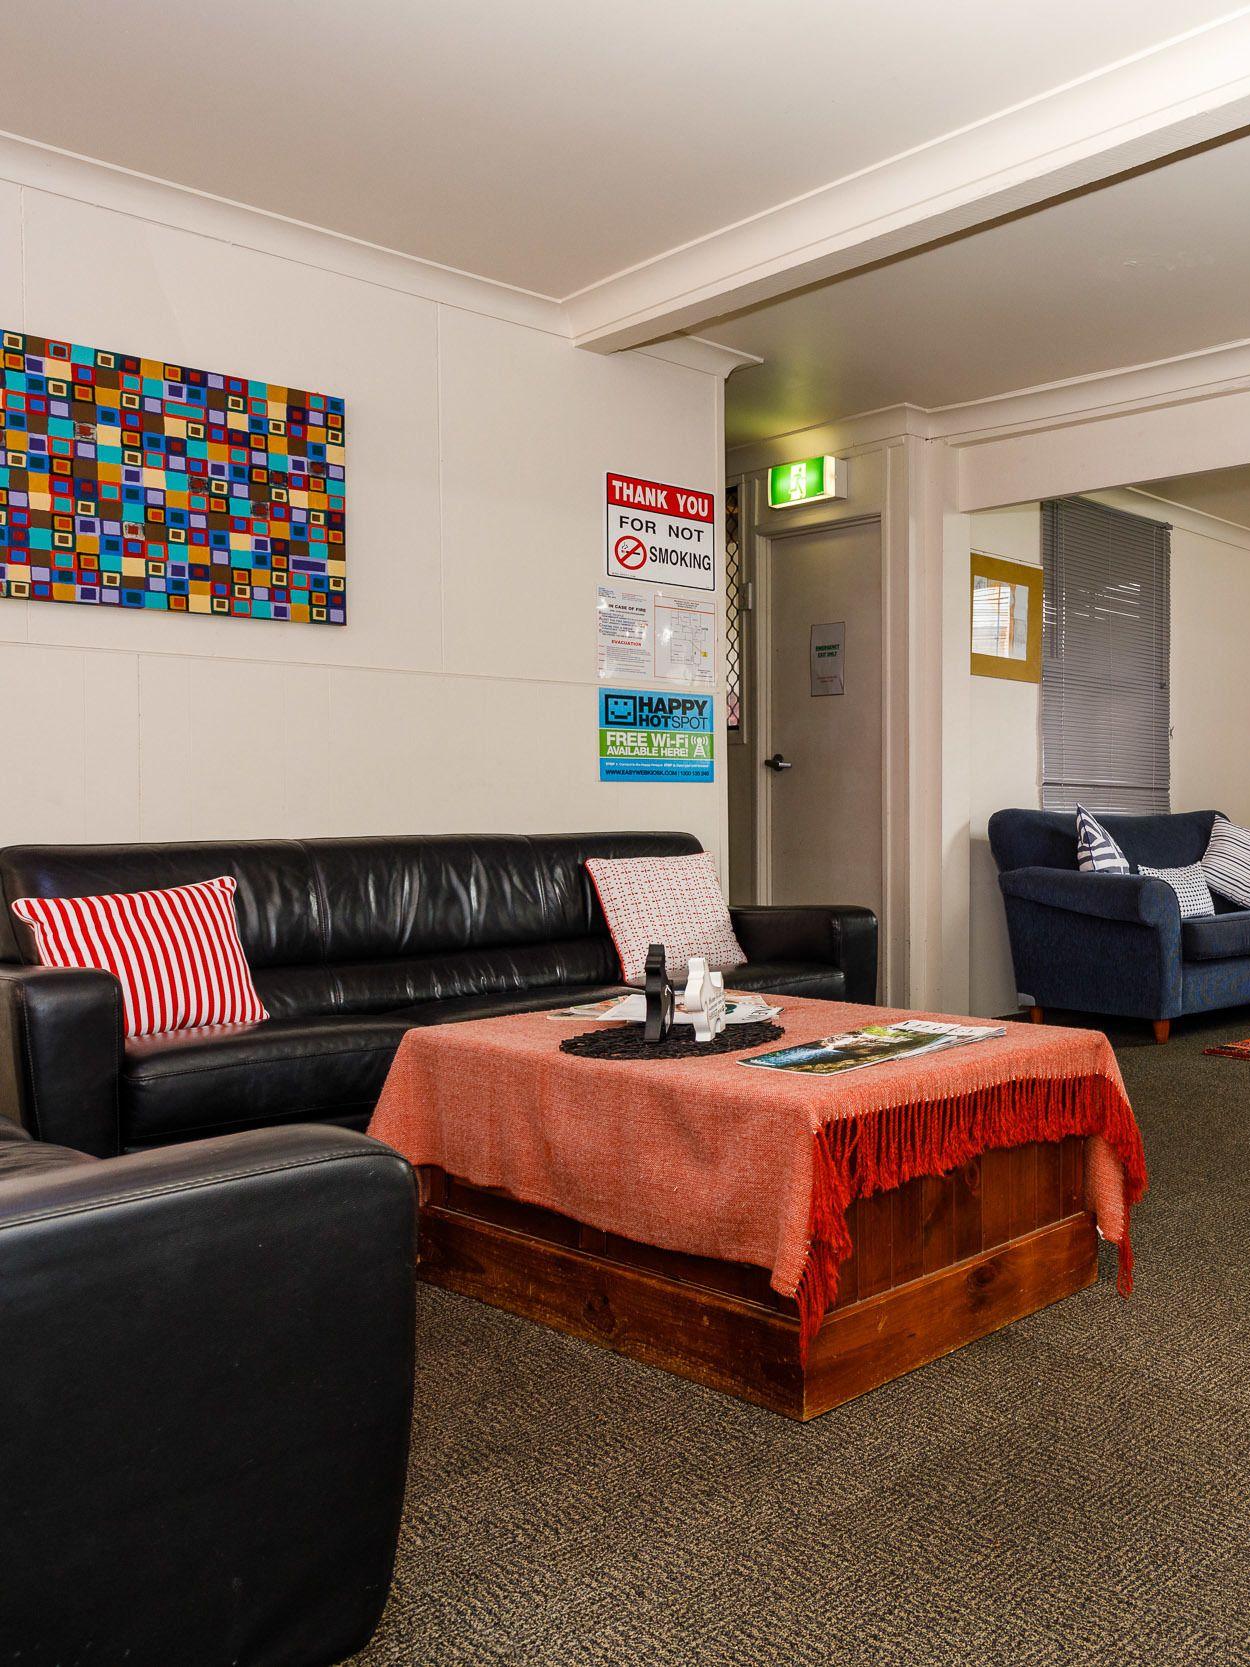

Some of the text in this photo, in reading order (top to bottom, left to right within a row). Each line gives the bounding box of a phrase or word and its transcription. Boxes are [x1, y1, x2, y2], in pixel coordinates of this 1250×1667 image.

[612, 480, 708, 517] THANK YOU
[619, 515, 704, 542] FOR NOT
[649, 546, 711, 571] SMOKING
[638, 696, 707, 716] HAPPY
[639, 714, 708, 729] HOTSPOT
[606, 731, 688, 748] FREE Wi-Fi
[606, 746, 688, 757] AVAILABLE HERE!
